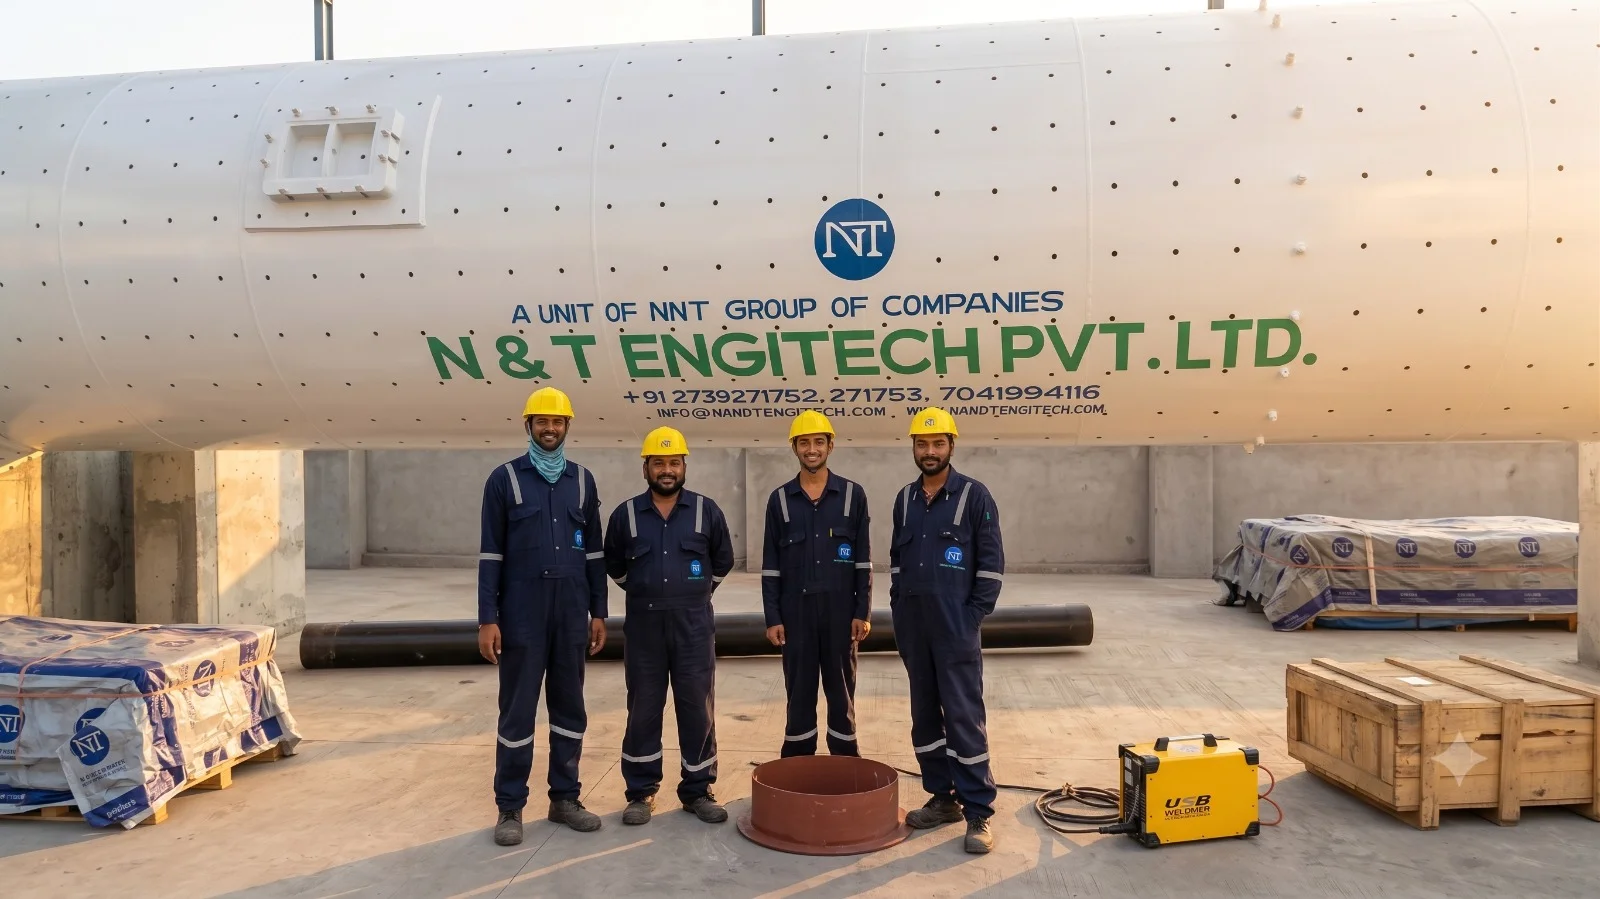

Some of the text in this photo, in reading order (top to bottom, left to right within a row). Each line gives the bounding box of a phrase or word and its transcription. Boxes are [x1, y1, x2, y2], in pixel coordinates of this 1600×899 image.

[822, 220, 887, 258] NT
[511, 290, 1064, 324] A UNIT OF NNT GROUP OF COMPANIES
[426, 318, 1318, 380] N & T ENGITECH PVT. LTD.
[623, 390, 667, 404] +91
[939, 385, 1102, 401] 7041994116
[656, 406, 887, 420] INFO@NANDTENGICH.COM
[1333, 542, 1352, 553] NT
[1397, 542, 1416, 554] NT
[1456, 542, 1475, 553] NT
[1520, 541, 1538, 553] NT
[72, 730, 105, 758] NT
[1164, 806, 1210, 816] WELDMER
